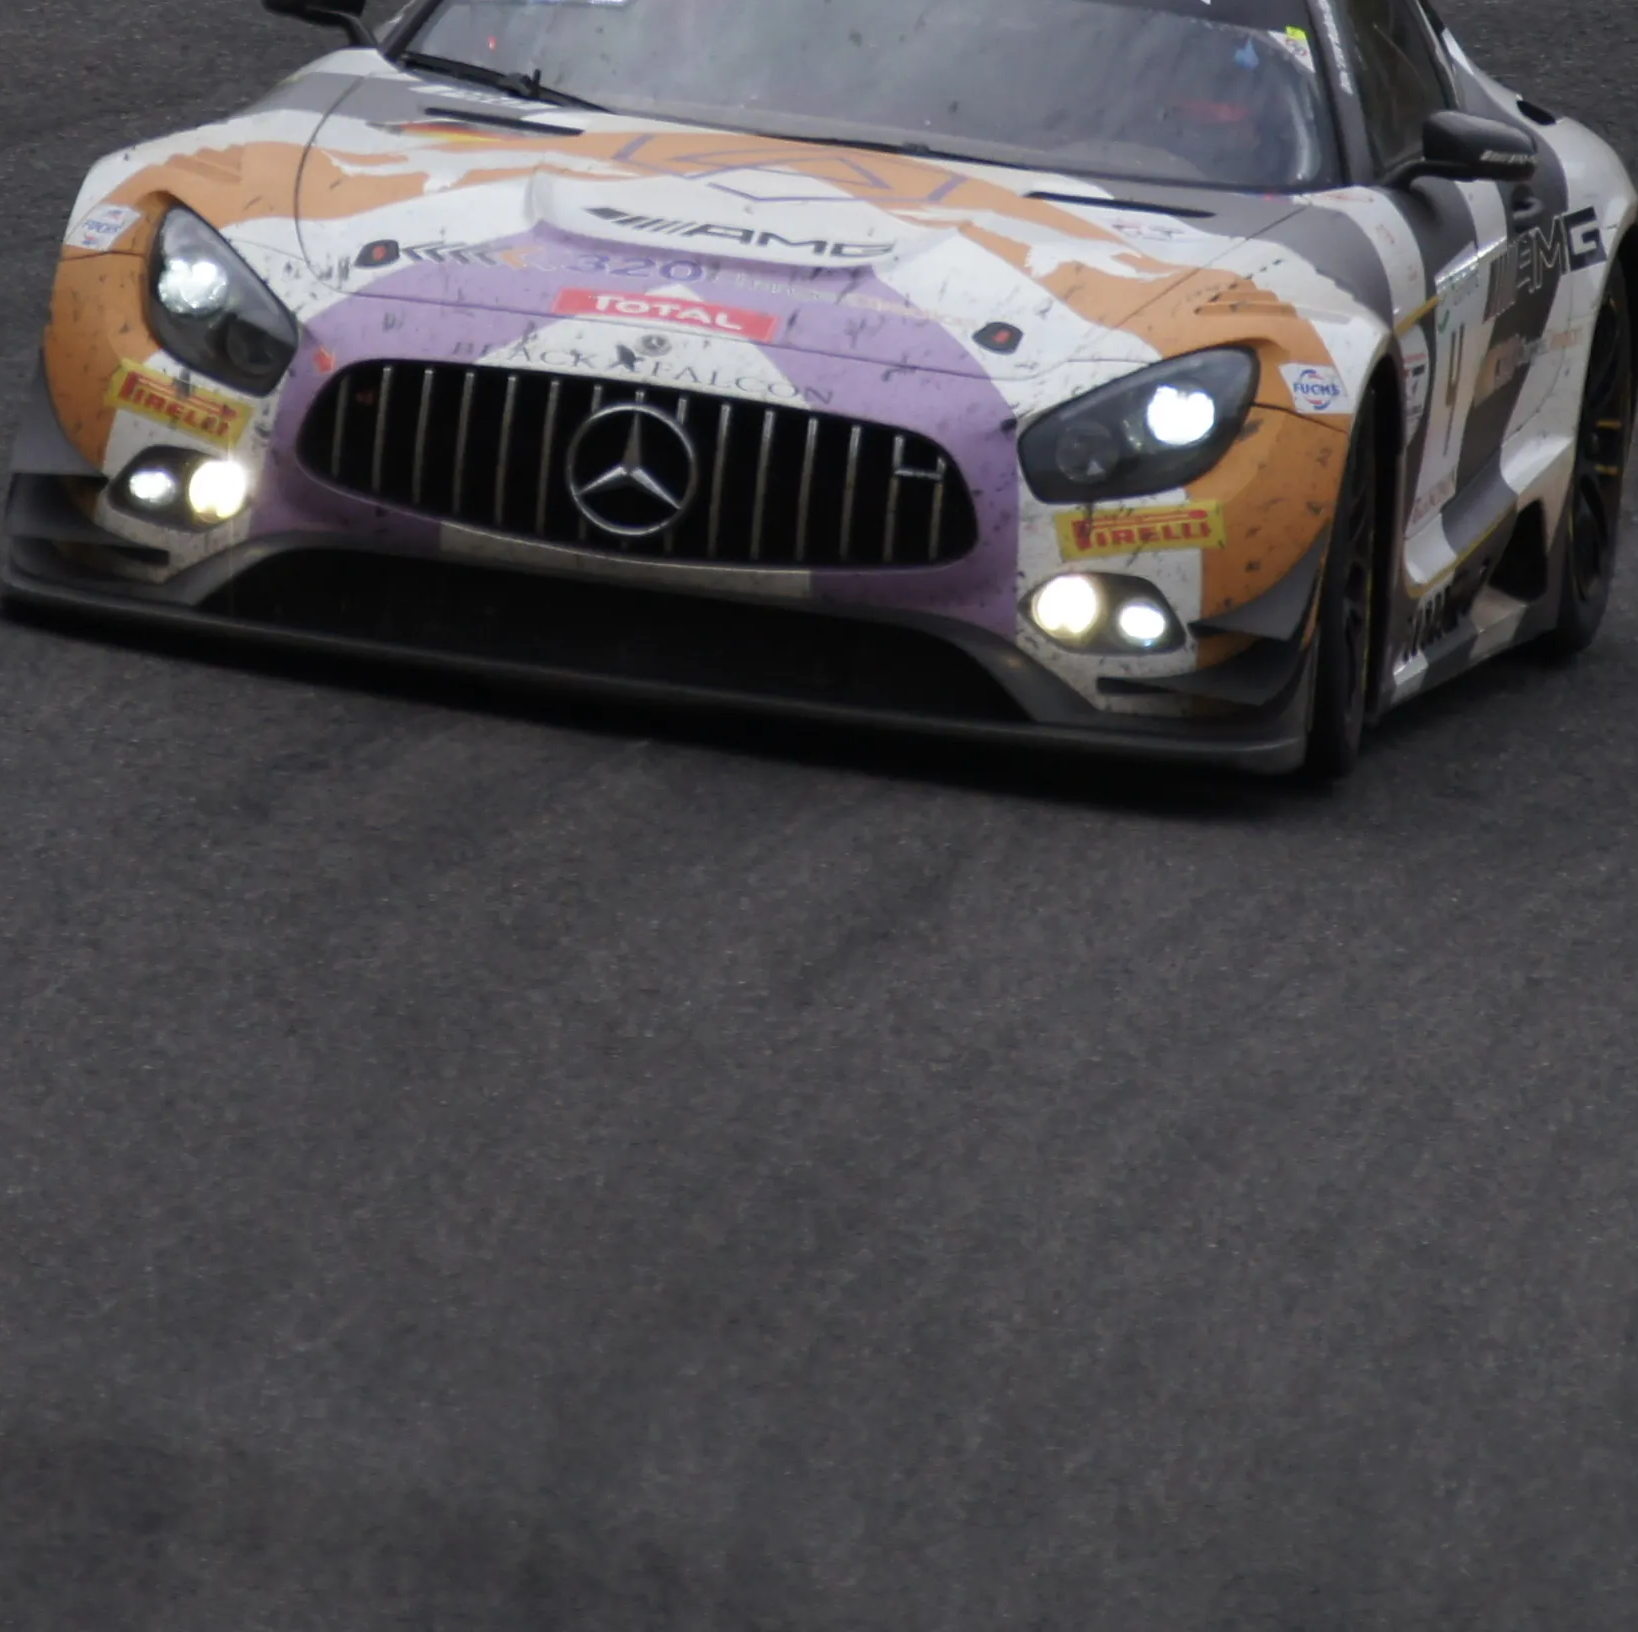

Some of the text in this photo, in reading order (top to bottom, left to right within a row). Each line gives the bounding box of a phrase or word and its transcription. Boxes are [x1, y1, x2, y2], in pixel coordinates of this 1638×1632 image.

[564, 253, 705, 283] 320
[593, 294, 743, 331] TOTAL
[117, 370, 237, 436] PIRELLI
[1292, 381, 1342, 397] FUCHS
[1071, 509, 1213, 552] PIRELLI
